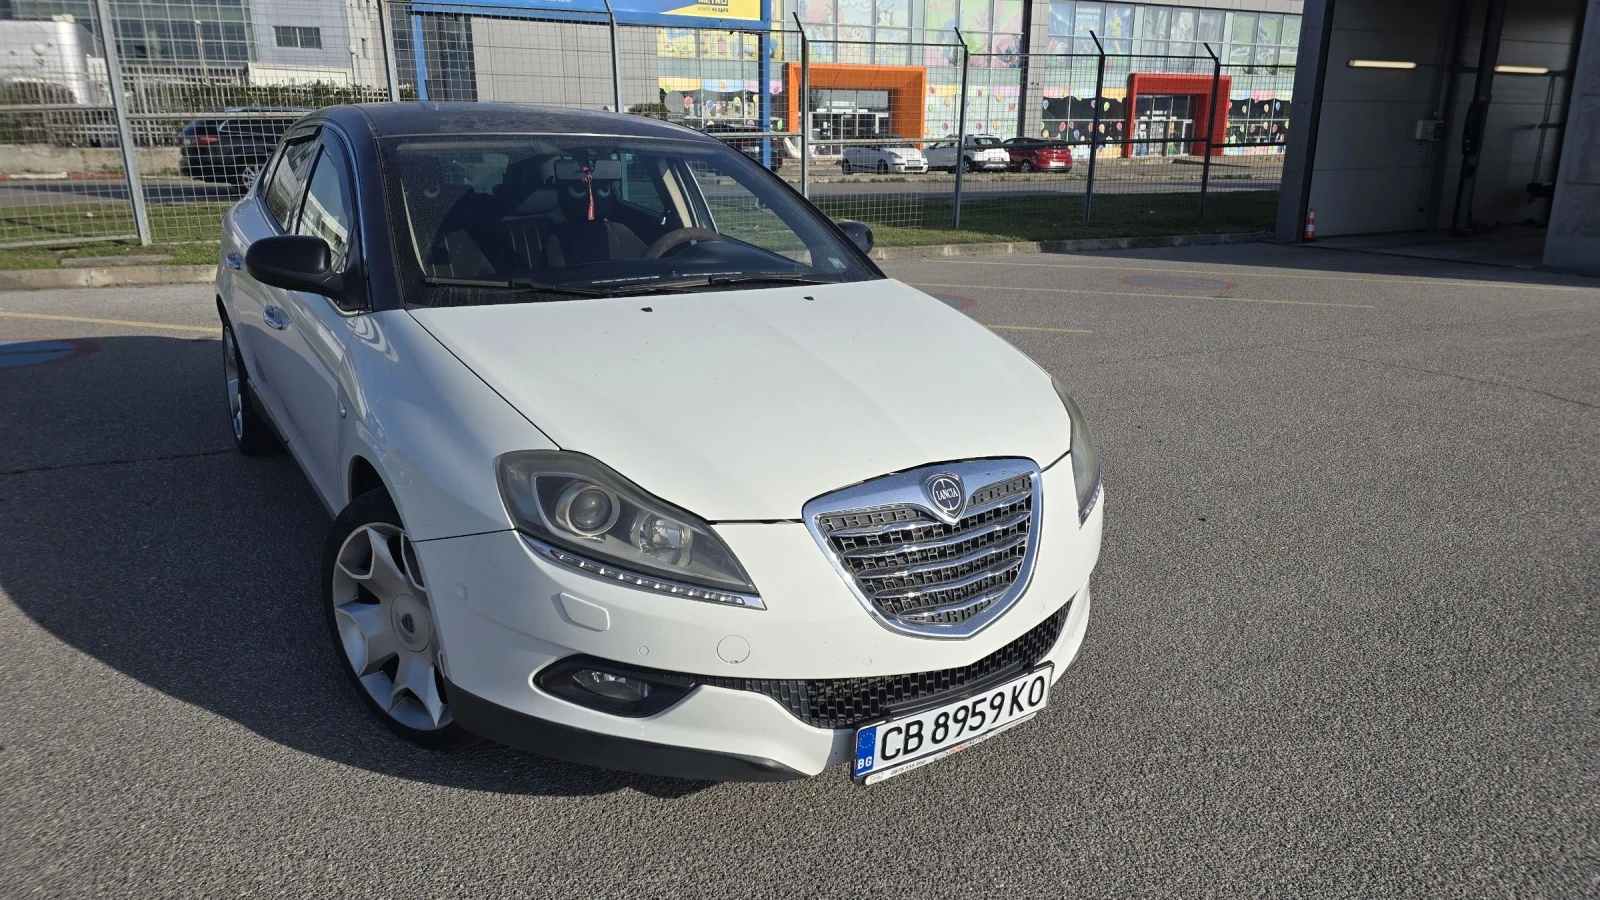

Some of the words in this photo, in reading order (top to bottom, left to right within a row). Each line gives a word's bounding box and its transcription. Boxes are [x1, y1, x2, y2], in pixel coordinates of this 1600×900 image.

[935, 487, 959, 501] LANCIA
[880, 720, 925, 761] CB
[931, 692, 1006, 745] 8959
[1009, 675, 1045, 716] KO
[857, 755, 873, 770] BG
